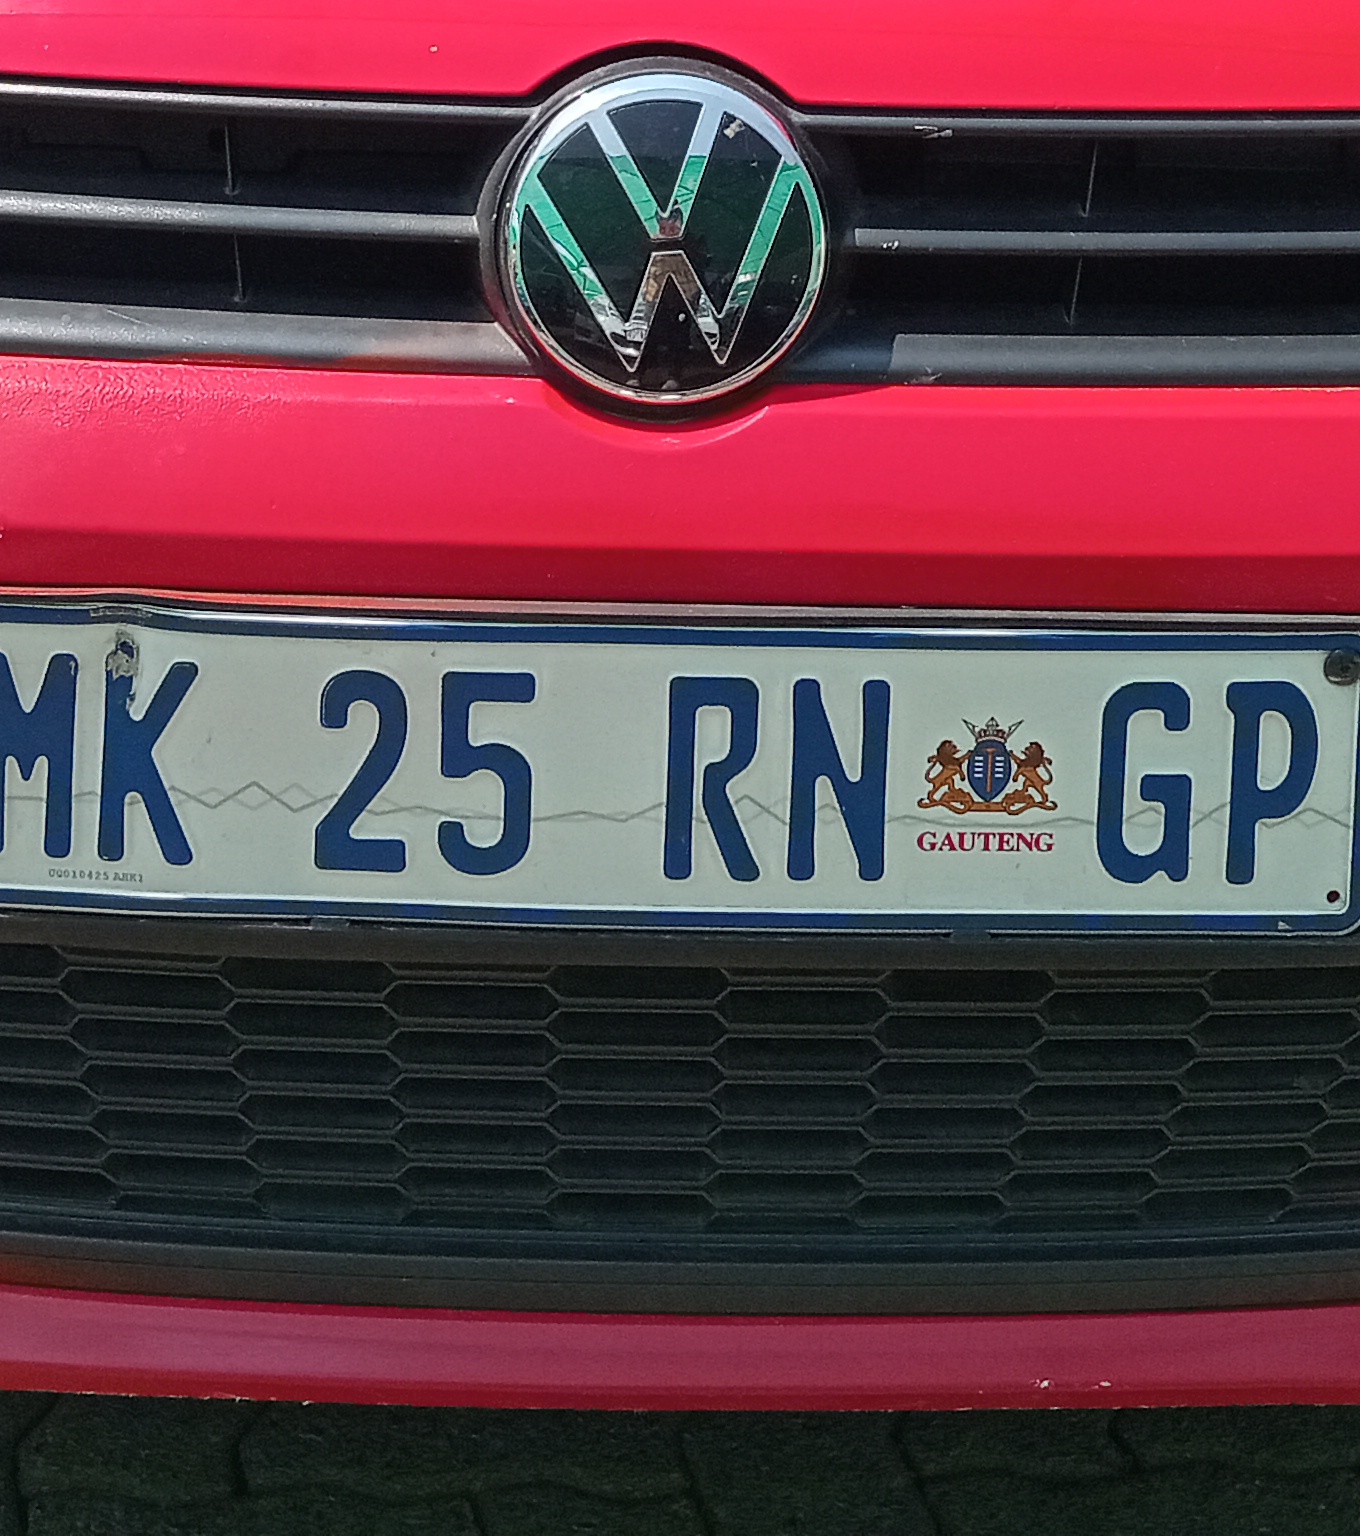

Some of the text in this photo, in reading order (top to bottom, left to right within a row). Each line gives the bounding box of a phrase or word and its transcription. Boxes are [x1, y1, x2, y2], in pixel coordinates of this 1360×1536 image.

[315, 670, 536, 876] 25
[663, 676, 891, 882] RN
[1096, 680, 1319, 885] GP
[916, 830, 1055, 852] GAUTENG
